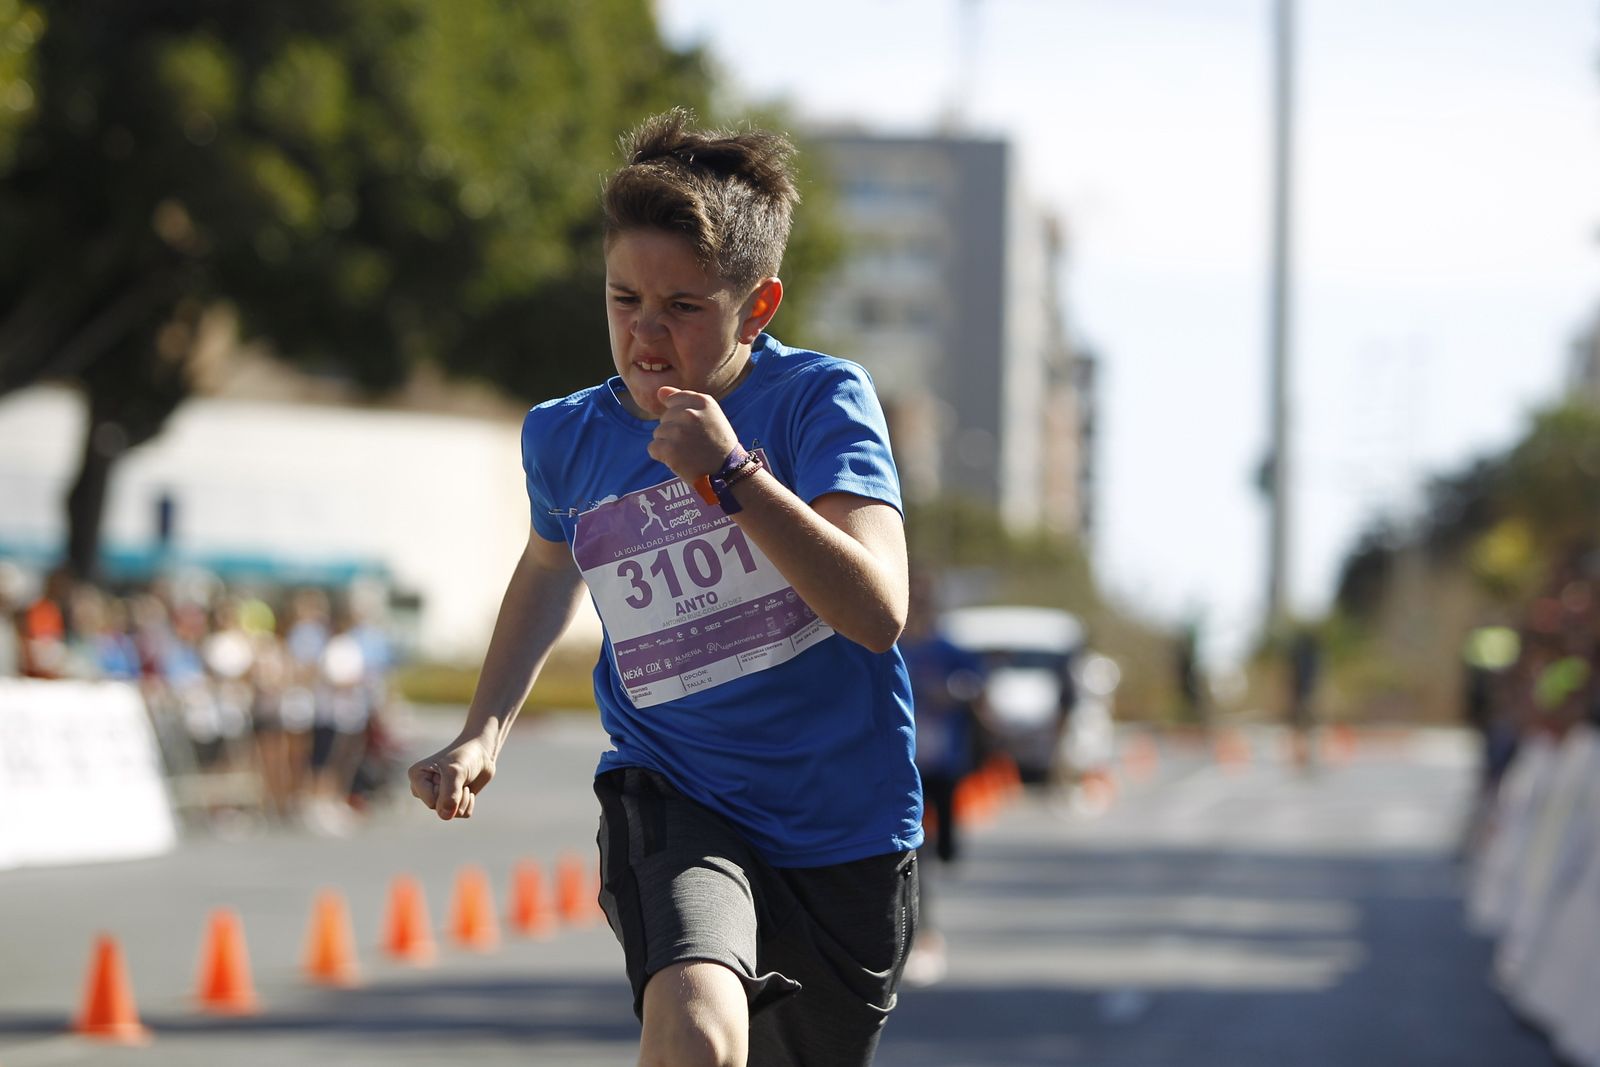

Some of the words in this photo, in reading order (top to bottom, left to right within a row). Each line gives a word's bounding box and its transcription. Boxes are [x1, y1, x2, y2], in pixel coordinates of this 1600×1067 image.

[657, 480, 691, 501] VIII
[664, 497, 696, 512] CARRERA
[613, 549, 623, 558] LA
[623, 537, 664, 555] IGUALDAD
[665, 533, 675, 542] ES
[676, 522, 712, 538] NUESTRA
[713, 515, 733, 527] MET
[617, 525, 758, 610] 3101
[675, 591, 719, 617] ANTO
